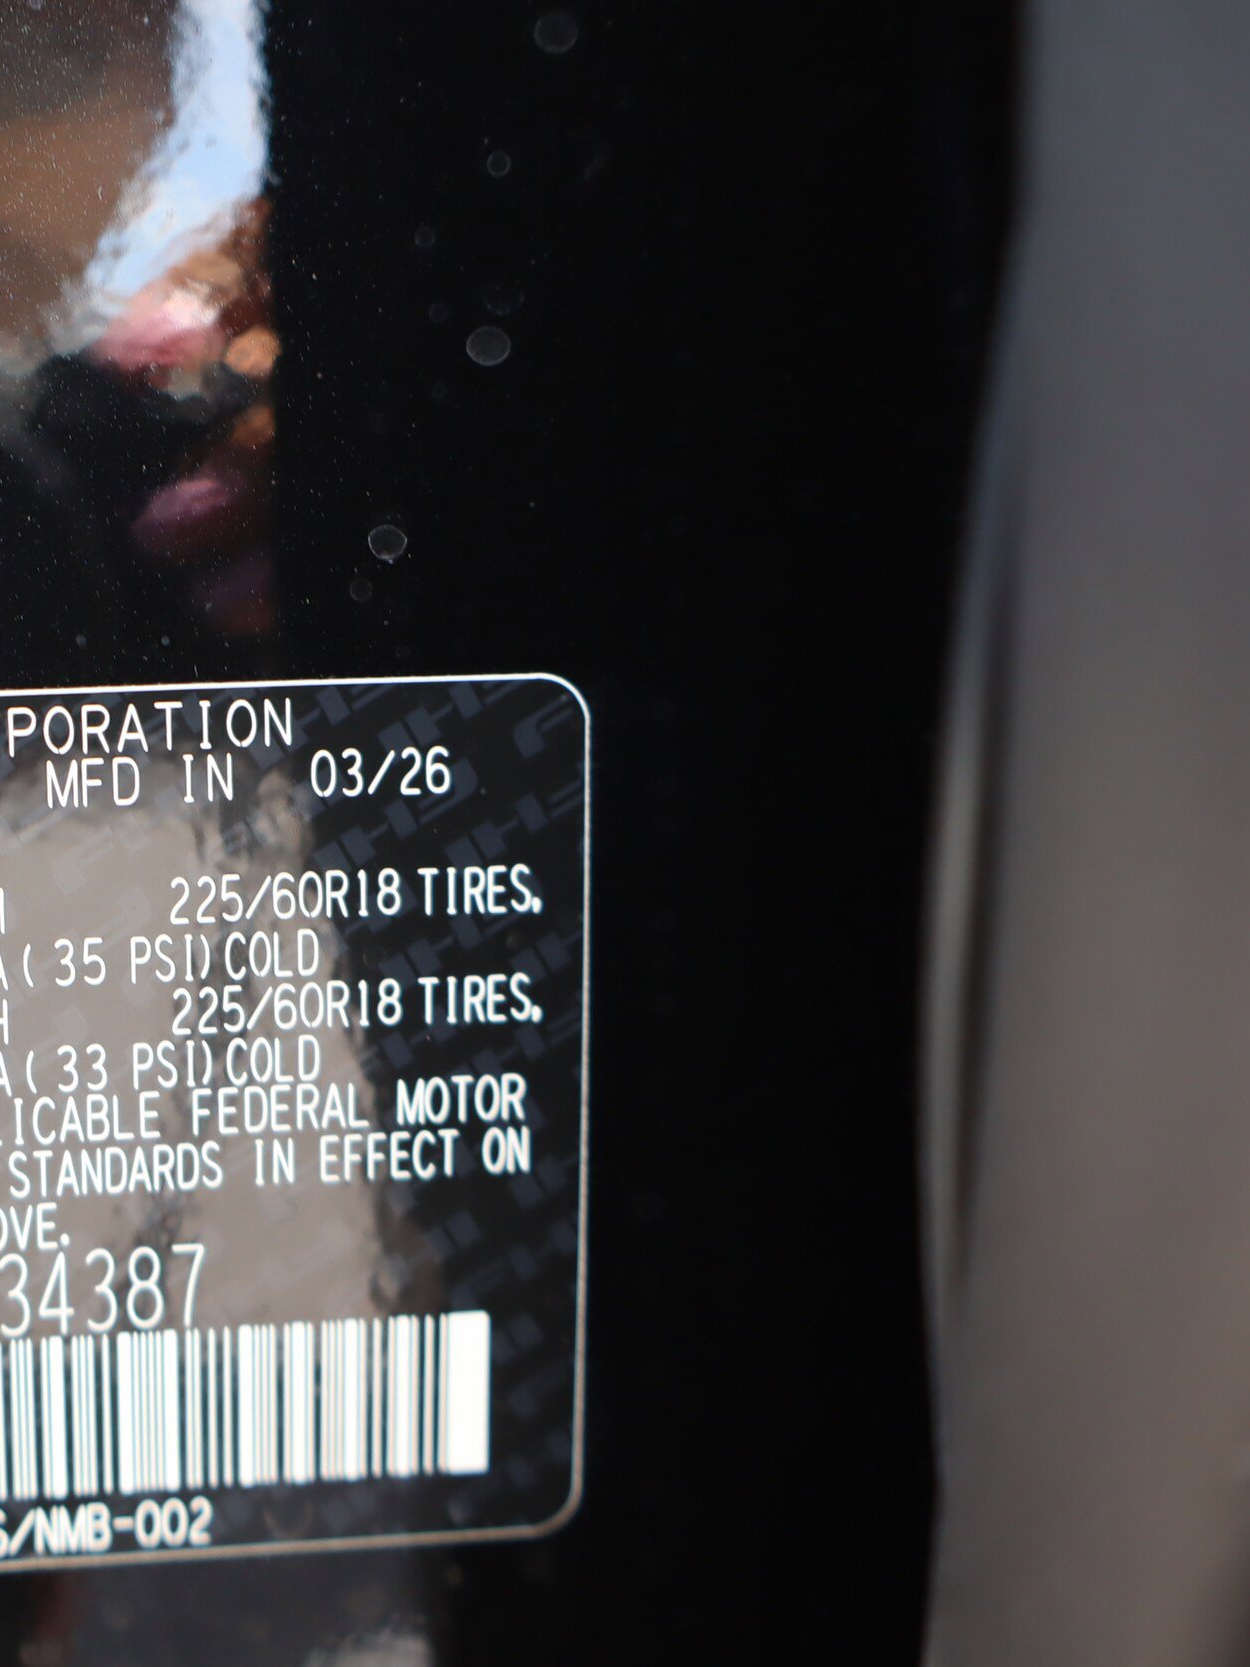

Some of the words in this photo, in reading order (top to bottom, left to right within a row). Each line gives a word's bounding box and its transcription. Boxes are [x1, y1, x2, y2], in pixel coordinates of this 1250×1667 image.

[48, 757, 140, 808] MFD
[184, 754, 232, 804] IN
[311, 747, 450, 797] 03/26
[170, 869, 401, 925] 225/60R18
[172, 978, 402, 1036] 225/60R18
[192, 1083, 369, 1136] FEDERAL
[398, 1074, 525, 1125] MOTOR
[8, 1142, 223, 1200] STANDARDS
[255, 1138, 295, 1187] IN
[320, 1130, 459, 1182] EFFECT
[483, 1128, 529, 1174] ON
